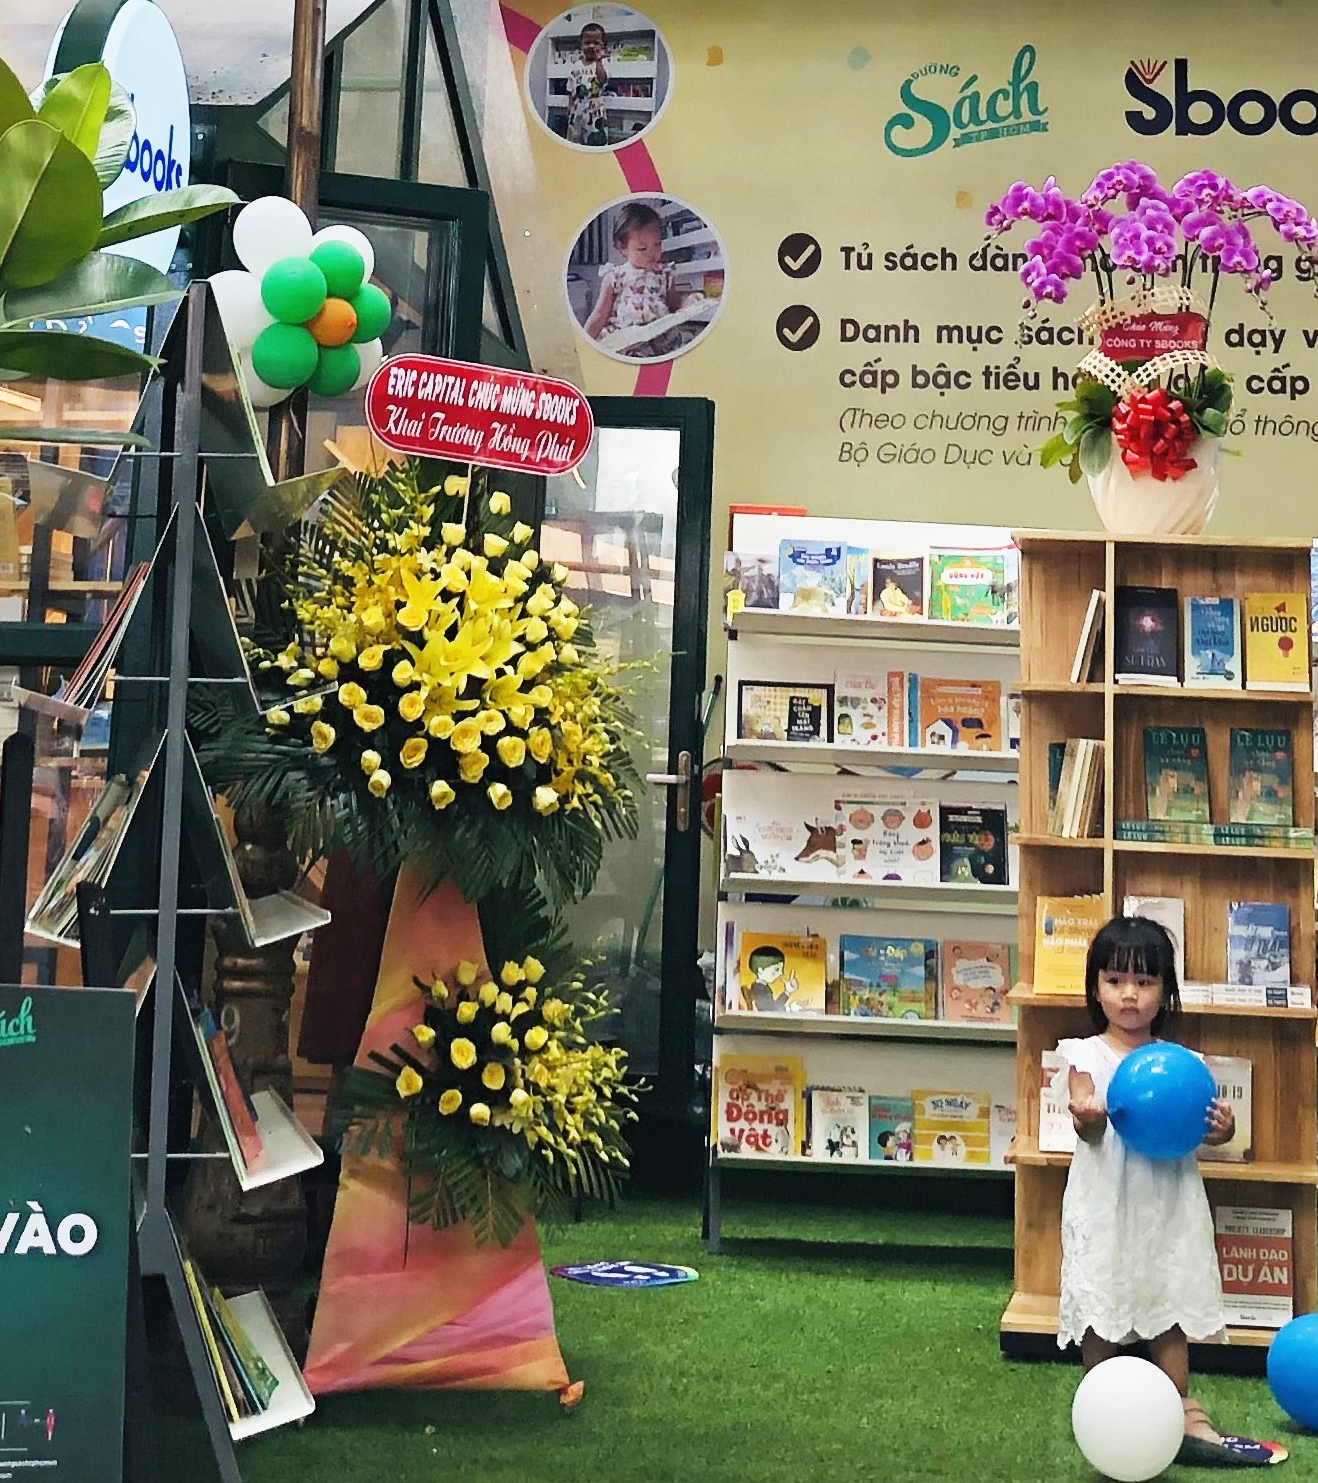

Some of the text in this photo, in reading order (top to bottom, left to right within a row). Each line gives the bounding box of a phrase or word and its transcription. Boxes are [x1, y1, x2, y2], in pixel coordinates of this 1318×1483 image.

[884, 44, 1048, 157] Sách
[839, 243, 873, 272] Tủ
[883, 244, 958, 271] sách
[969, 244, 1028, 272] dàn
[839, 318, 919, 343] Danh
[936, 322, 1003, 351] mục
[1020, 319, 1095, 346] sách
[1224, 323, 1286, 356] dạy
[1106, 337, 1198, 349] CÔNG TY SBOOKS
[839, 357, 900, 394] cấp
[912, 365, 971, 396] bậc
[982, 357, 1040, 391] tiểu
[1246, 363, 1310, 399] cấp
[387, 367, 415, 398] ERIC
[417, 371, 466, 406] CAPITAL
[467, 376, 500, 412] CHÚC
[535, 392, 580, 426] SBOOKS
[381, 405, 424, 438] Khai
[532, 430, 576, 463] Phát
[839, 407, 906, 433] (Theo
[913, 410, 1008, 436] chương
[1016, 410, 1067, 432] trình
[838, 443, 869, 467] Bộ
[877, 443, 936, 465] Giáo
[944, 444, 994, 469] Dục
[1002, 445, 1032, 465] và
[725, 1103, 788, 1126] Động
[1223, 1262, 1288, 1286] DỰ ÁN
